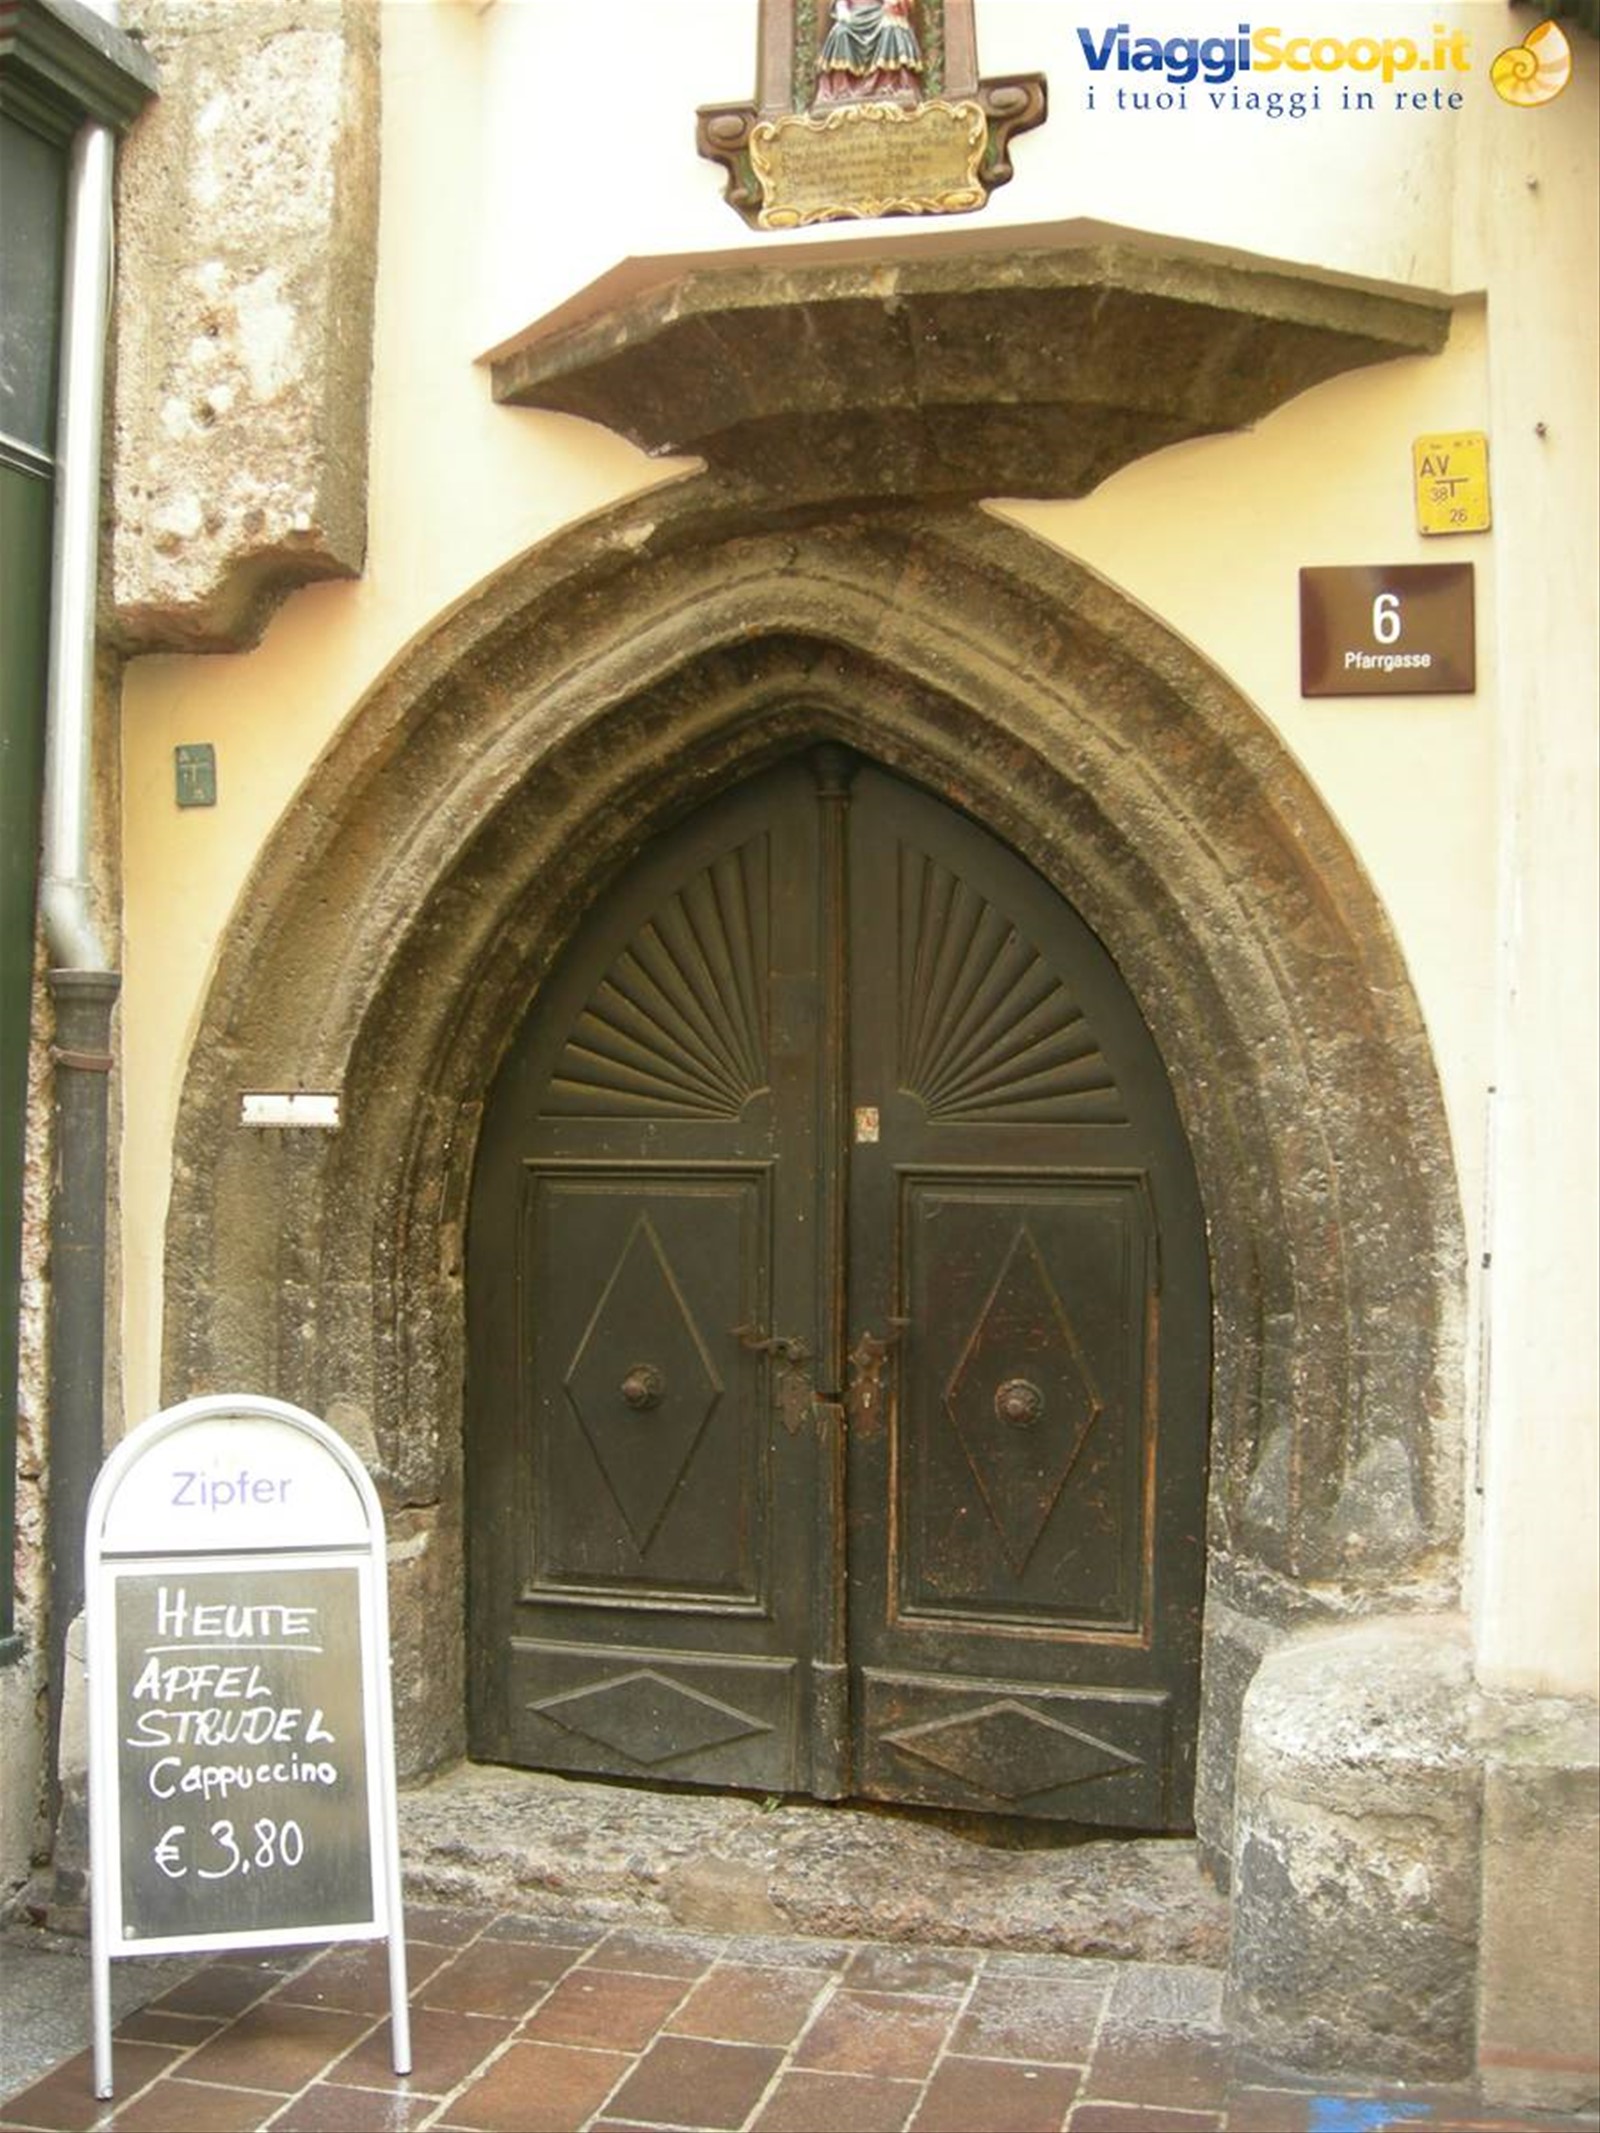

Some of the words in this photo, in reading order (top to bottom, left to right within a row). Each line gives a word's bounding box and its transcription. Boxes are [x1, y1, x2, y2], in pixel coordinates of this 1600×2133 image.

[1372, 593, 1401, 643] 6
[1344, 651, 1431, 672] Pfarrgasse
[171, 1470, 292, 1512] Zipfer
[157, 1587, 317, 1637] HEUTE
[132, 1656, 272, 1701] APFEL
[126, 1706, 335, 1747] STRUDEL
[150, 1752, 337, 1800] Cappuccino
